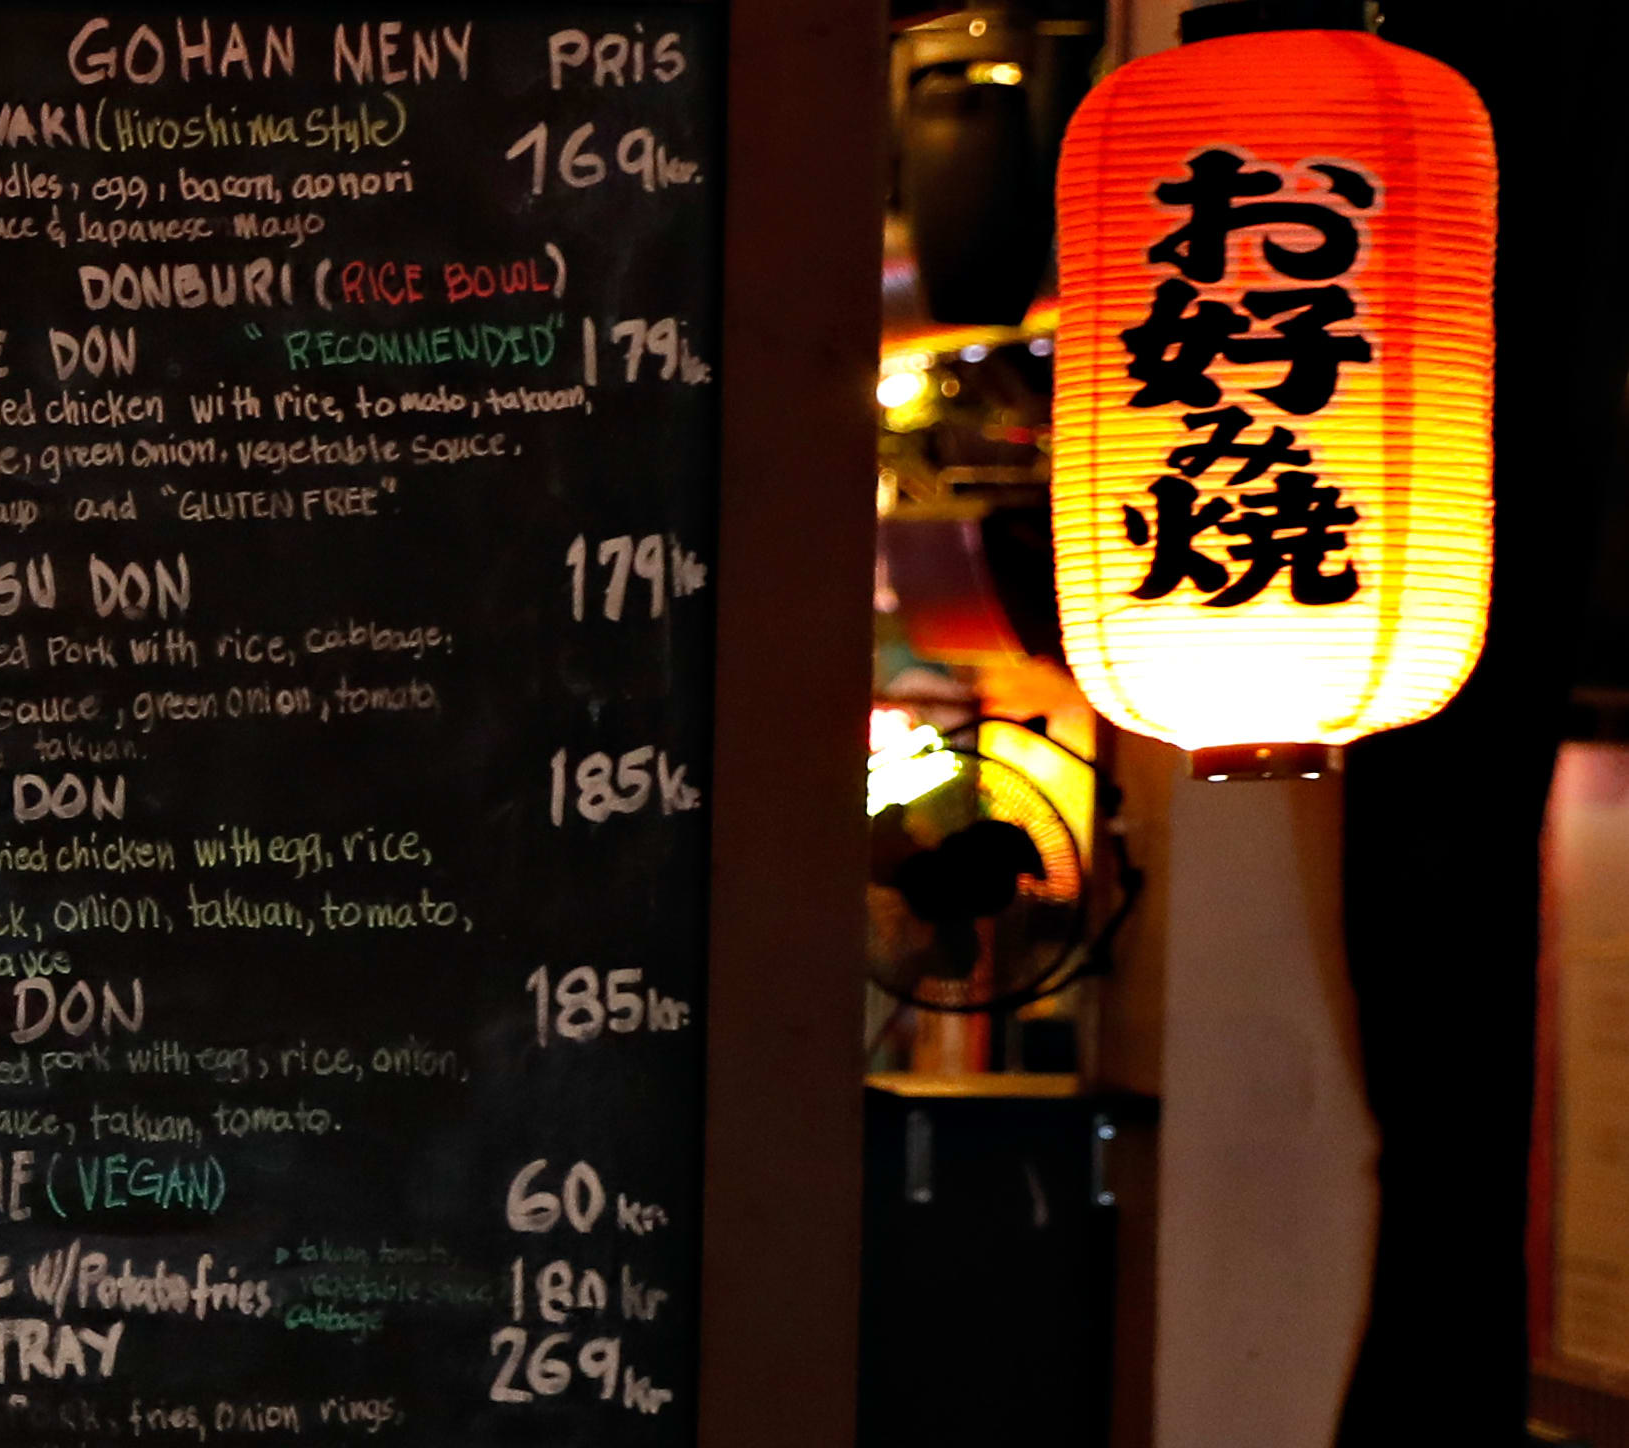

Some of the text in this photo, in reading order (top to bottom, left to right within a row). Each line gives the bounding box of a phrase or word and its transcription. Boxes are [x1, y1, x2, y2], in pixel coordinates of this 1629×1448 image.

[67, 16, 295, 85] GOHAN
[333, 20, 473, 85] MENY
[77, 256, 293, 311] DONBURI
[48, 323, 138, 382] DON
[1118, 145, 1379, 610] お好み焼
[89, 551, 193, 621] DON
[12, 772, 128, 825] DON
[10, 976, 146, 1046] DON
